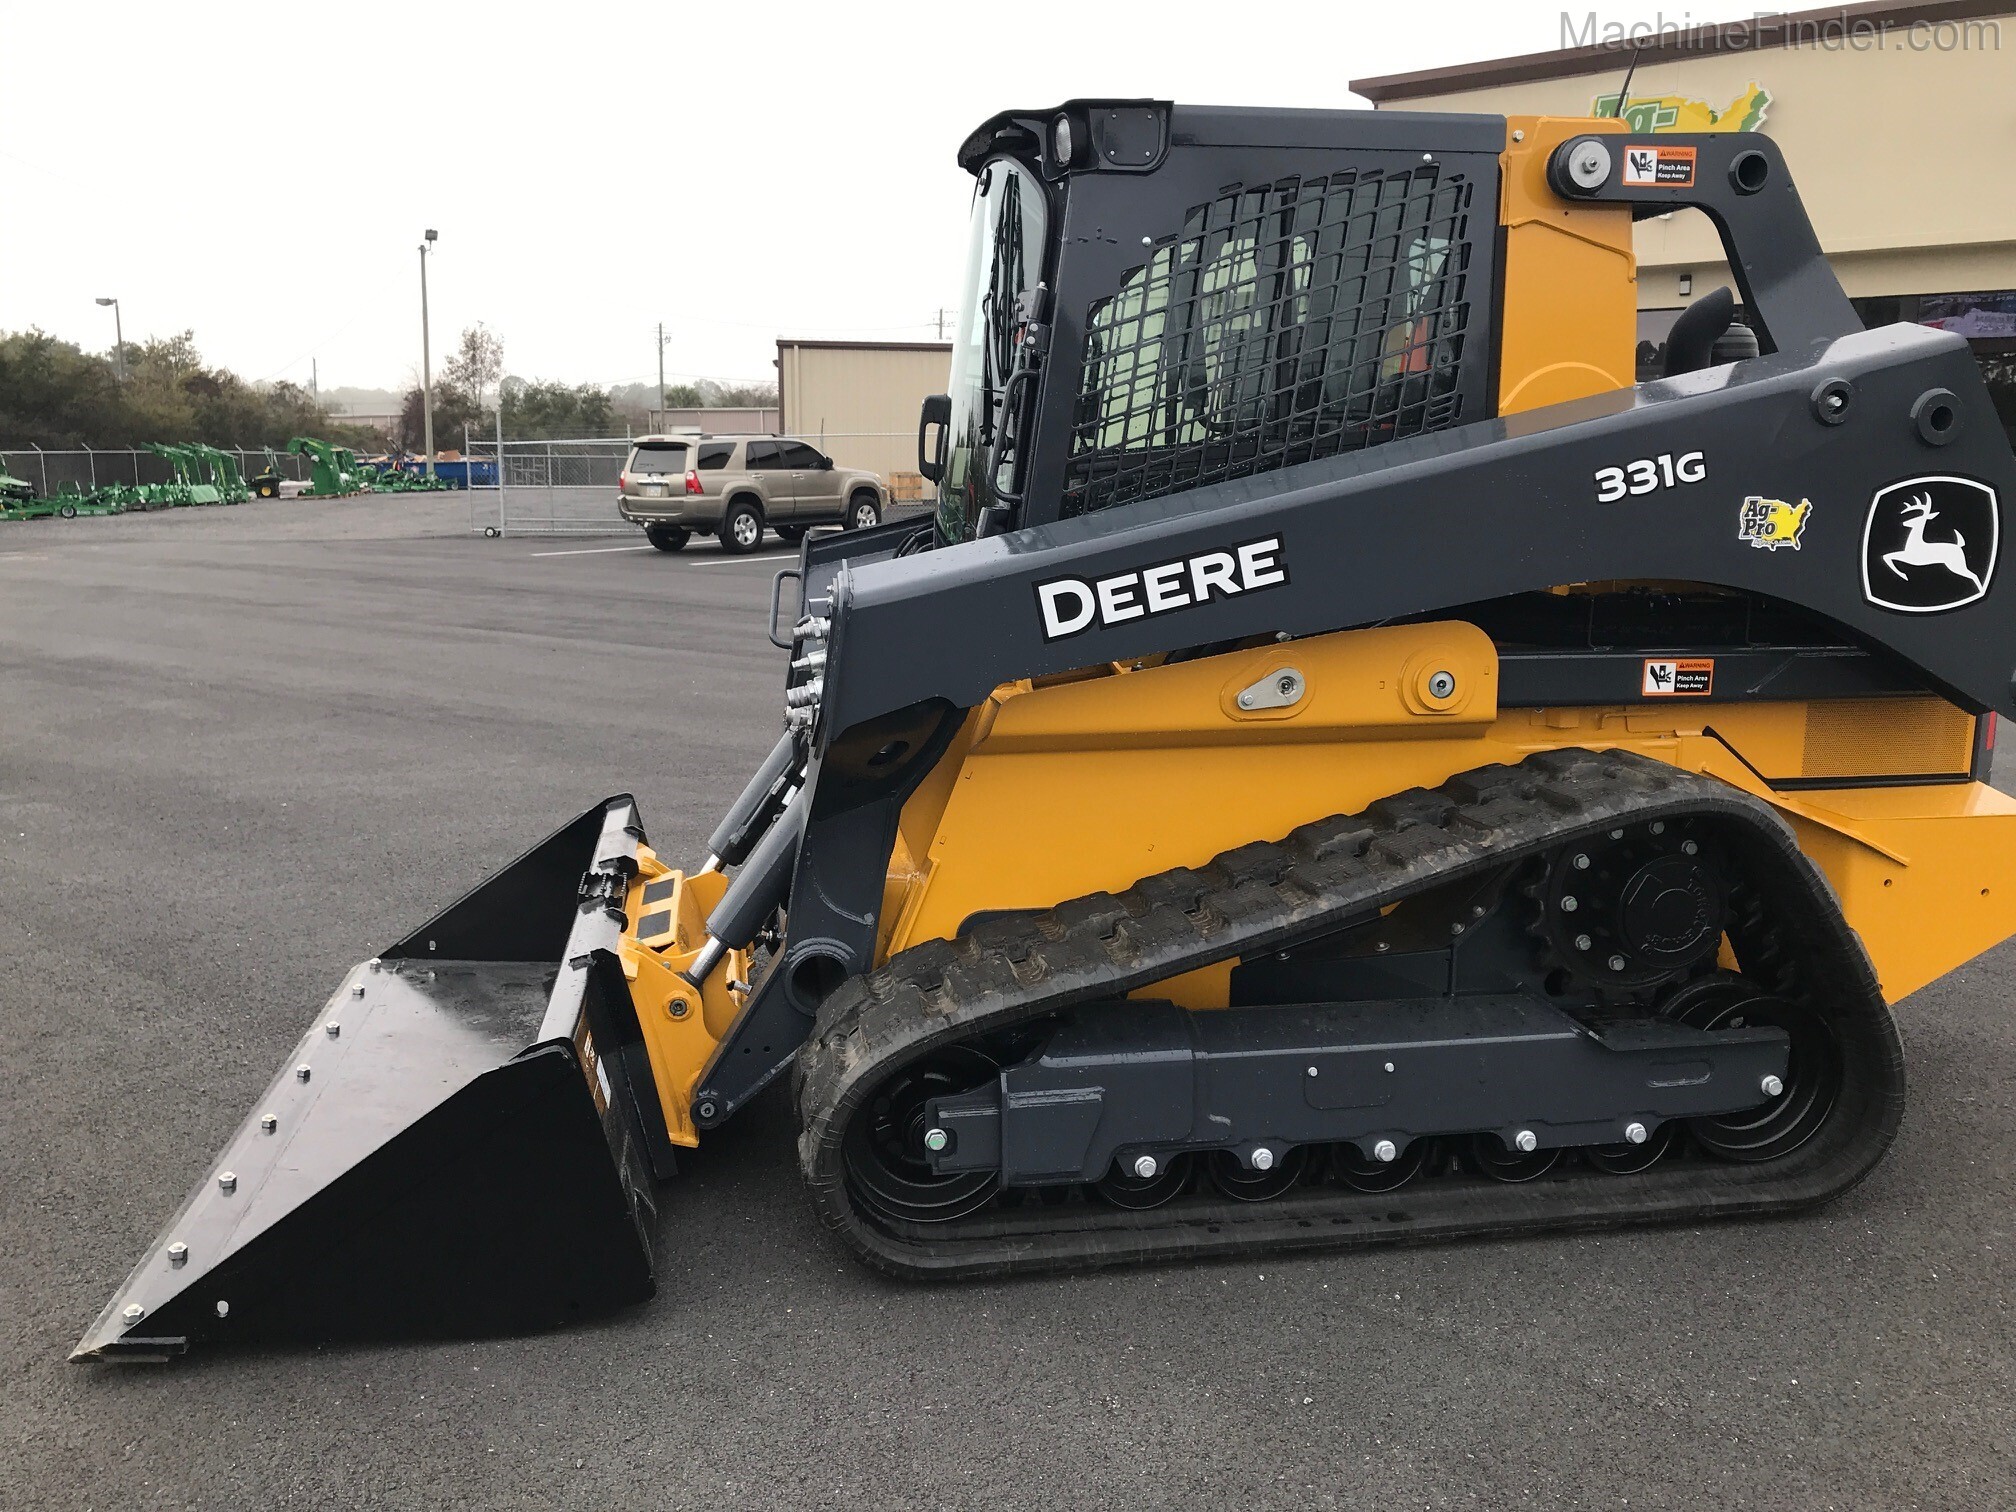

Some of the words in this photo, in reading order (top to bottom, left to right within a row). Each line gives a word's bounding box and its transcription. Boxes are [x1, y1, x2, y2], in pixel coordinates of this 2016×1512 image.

[1595, 451, 1706, 503] 331G
[1743, 519, 1776, 535] Pro
[1744, 499, 1778, 521] Ag-
[1038, 538, 1285, 638] DEERE
